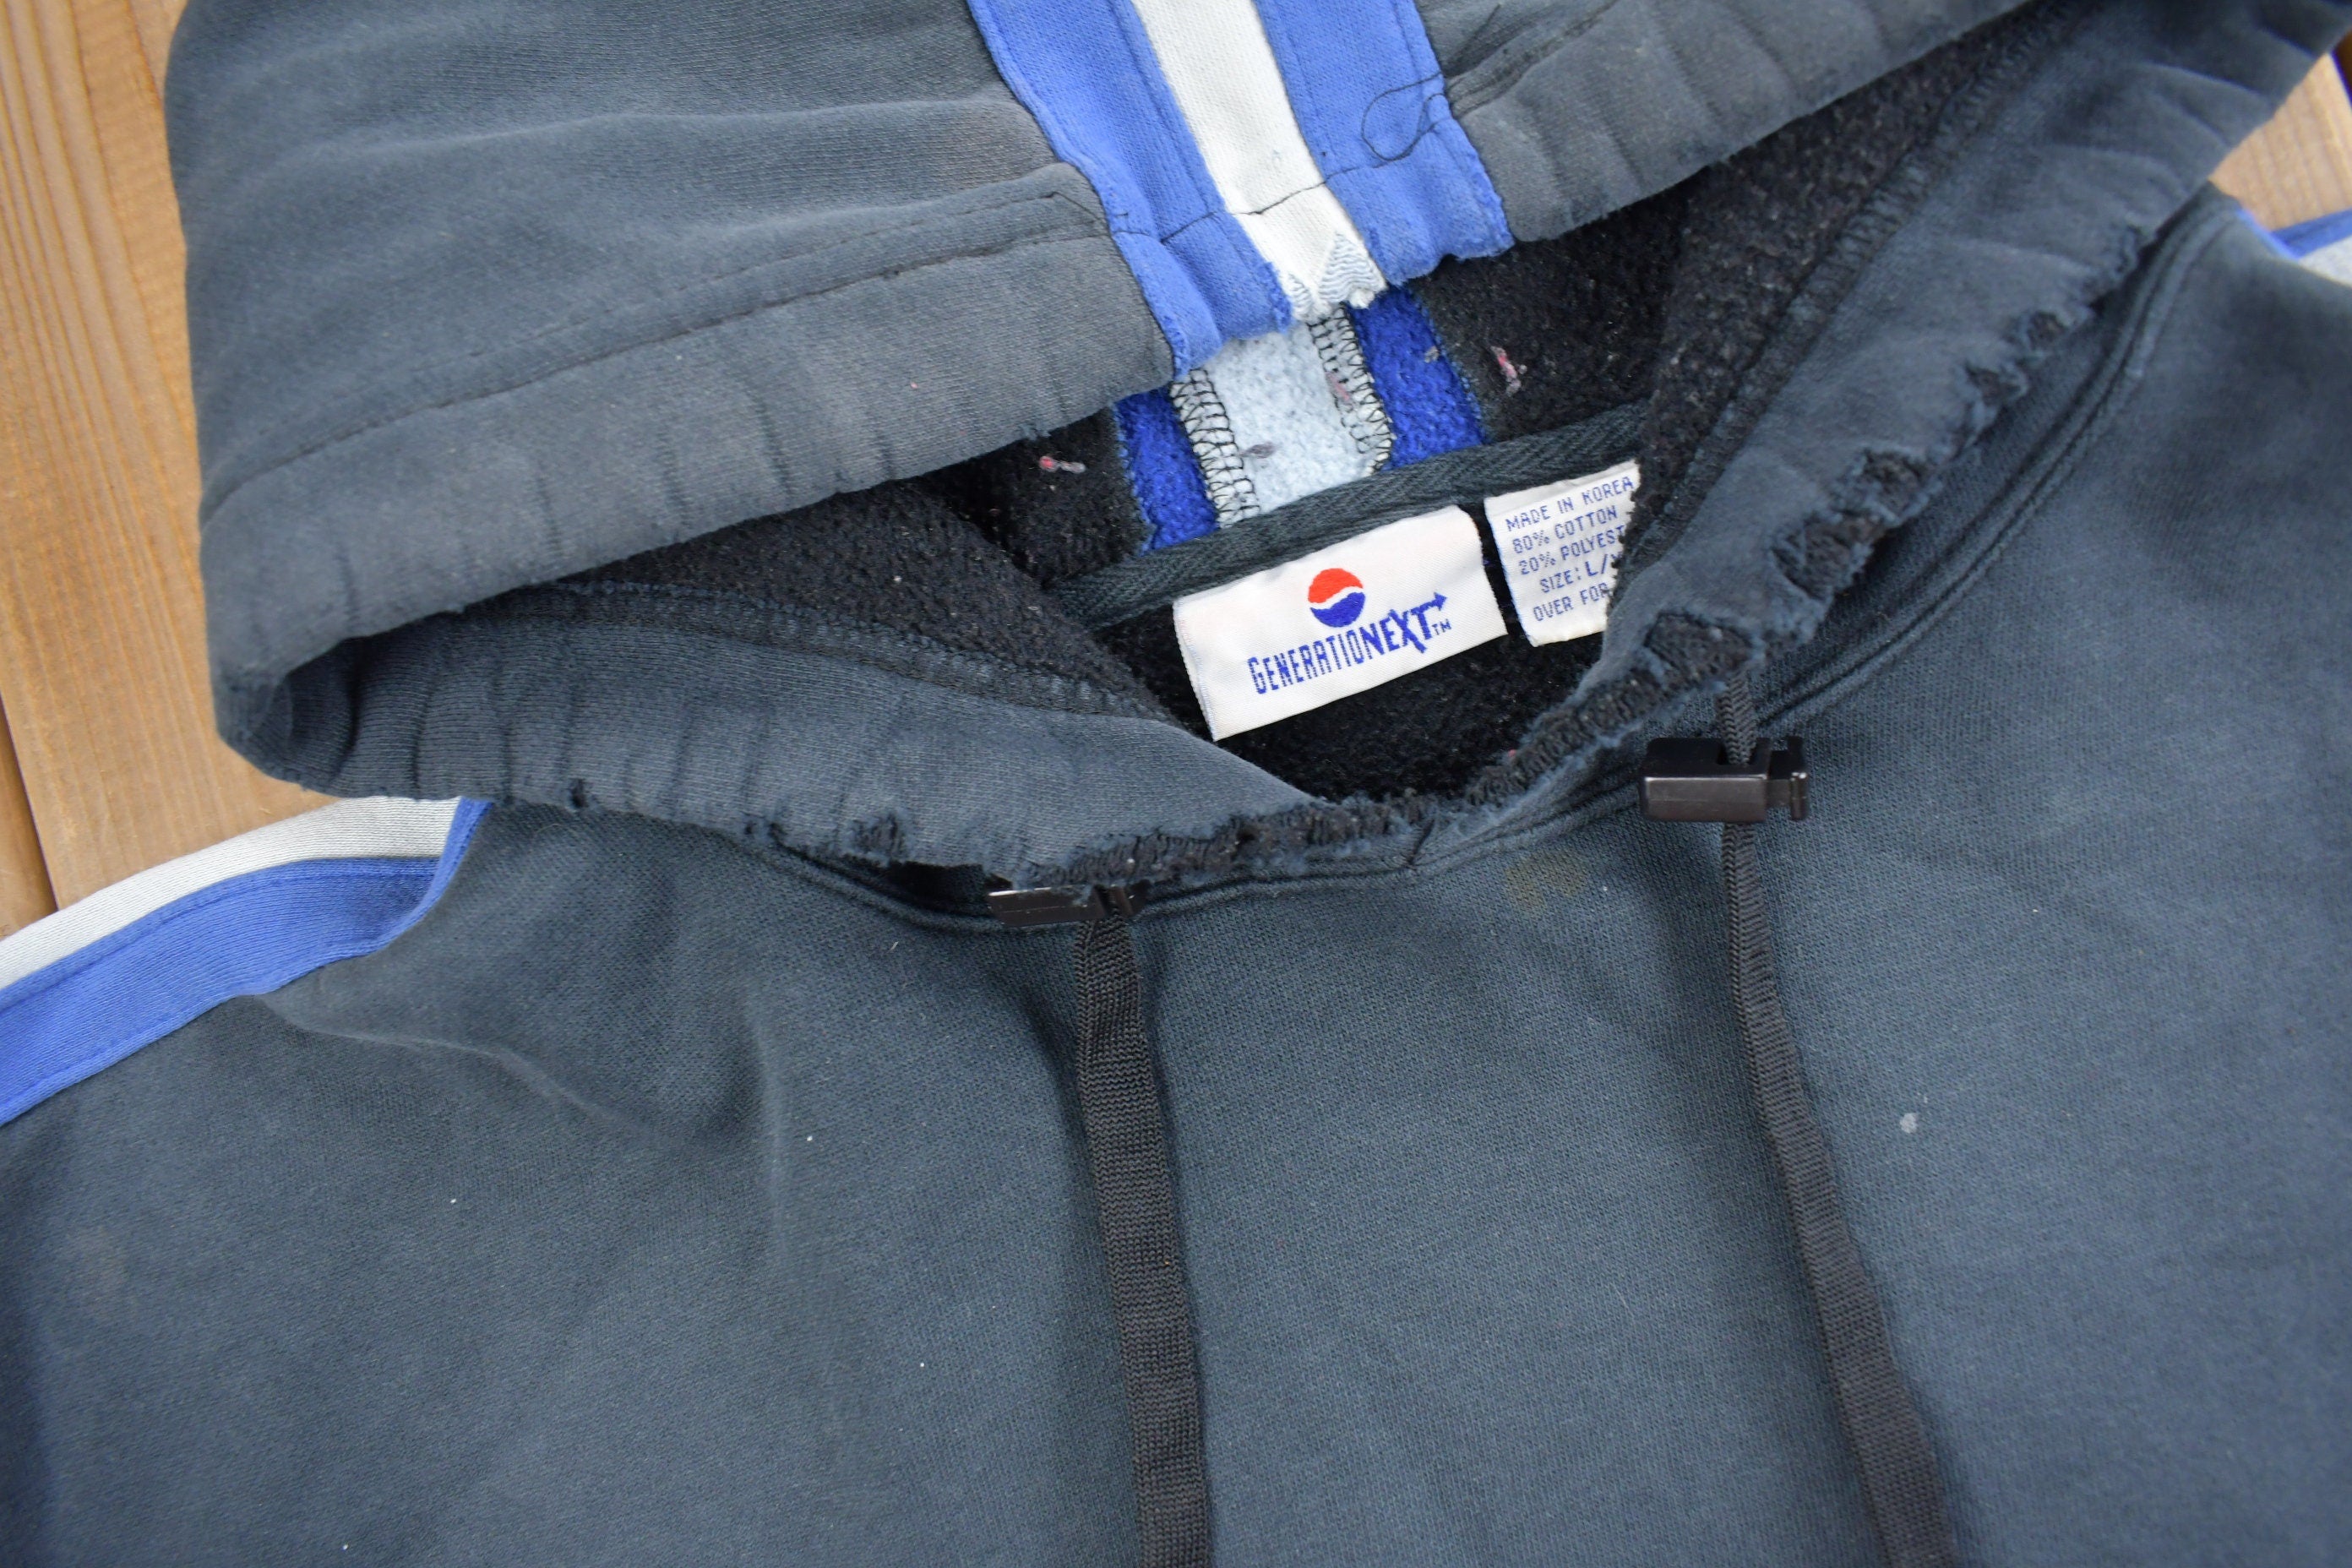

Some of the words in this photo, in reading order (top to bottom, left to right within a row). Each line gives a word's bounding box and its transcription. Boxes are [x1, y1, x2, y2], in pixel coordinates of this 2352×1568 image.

[1505, 504, 1551, 532] MADE
[1557, 496, 1575, 514] IN
[1582, 476, 1635, 505] KOREA
[1512, 530, 1550, 554] 80%
[1554, 504, 1618, 539] COTTON
[1518, 552, 1556, 575] 20%
[1539, 567, 1582, 594] SIZE:
[1533, 596, 1574, 622] OVER
[1580, 582, 1613, 605] FOR
[1248, 591, 1448, 694] GENERATIONEXT
